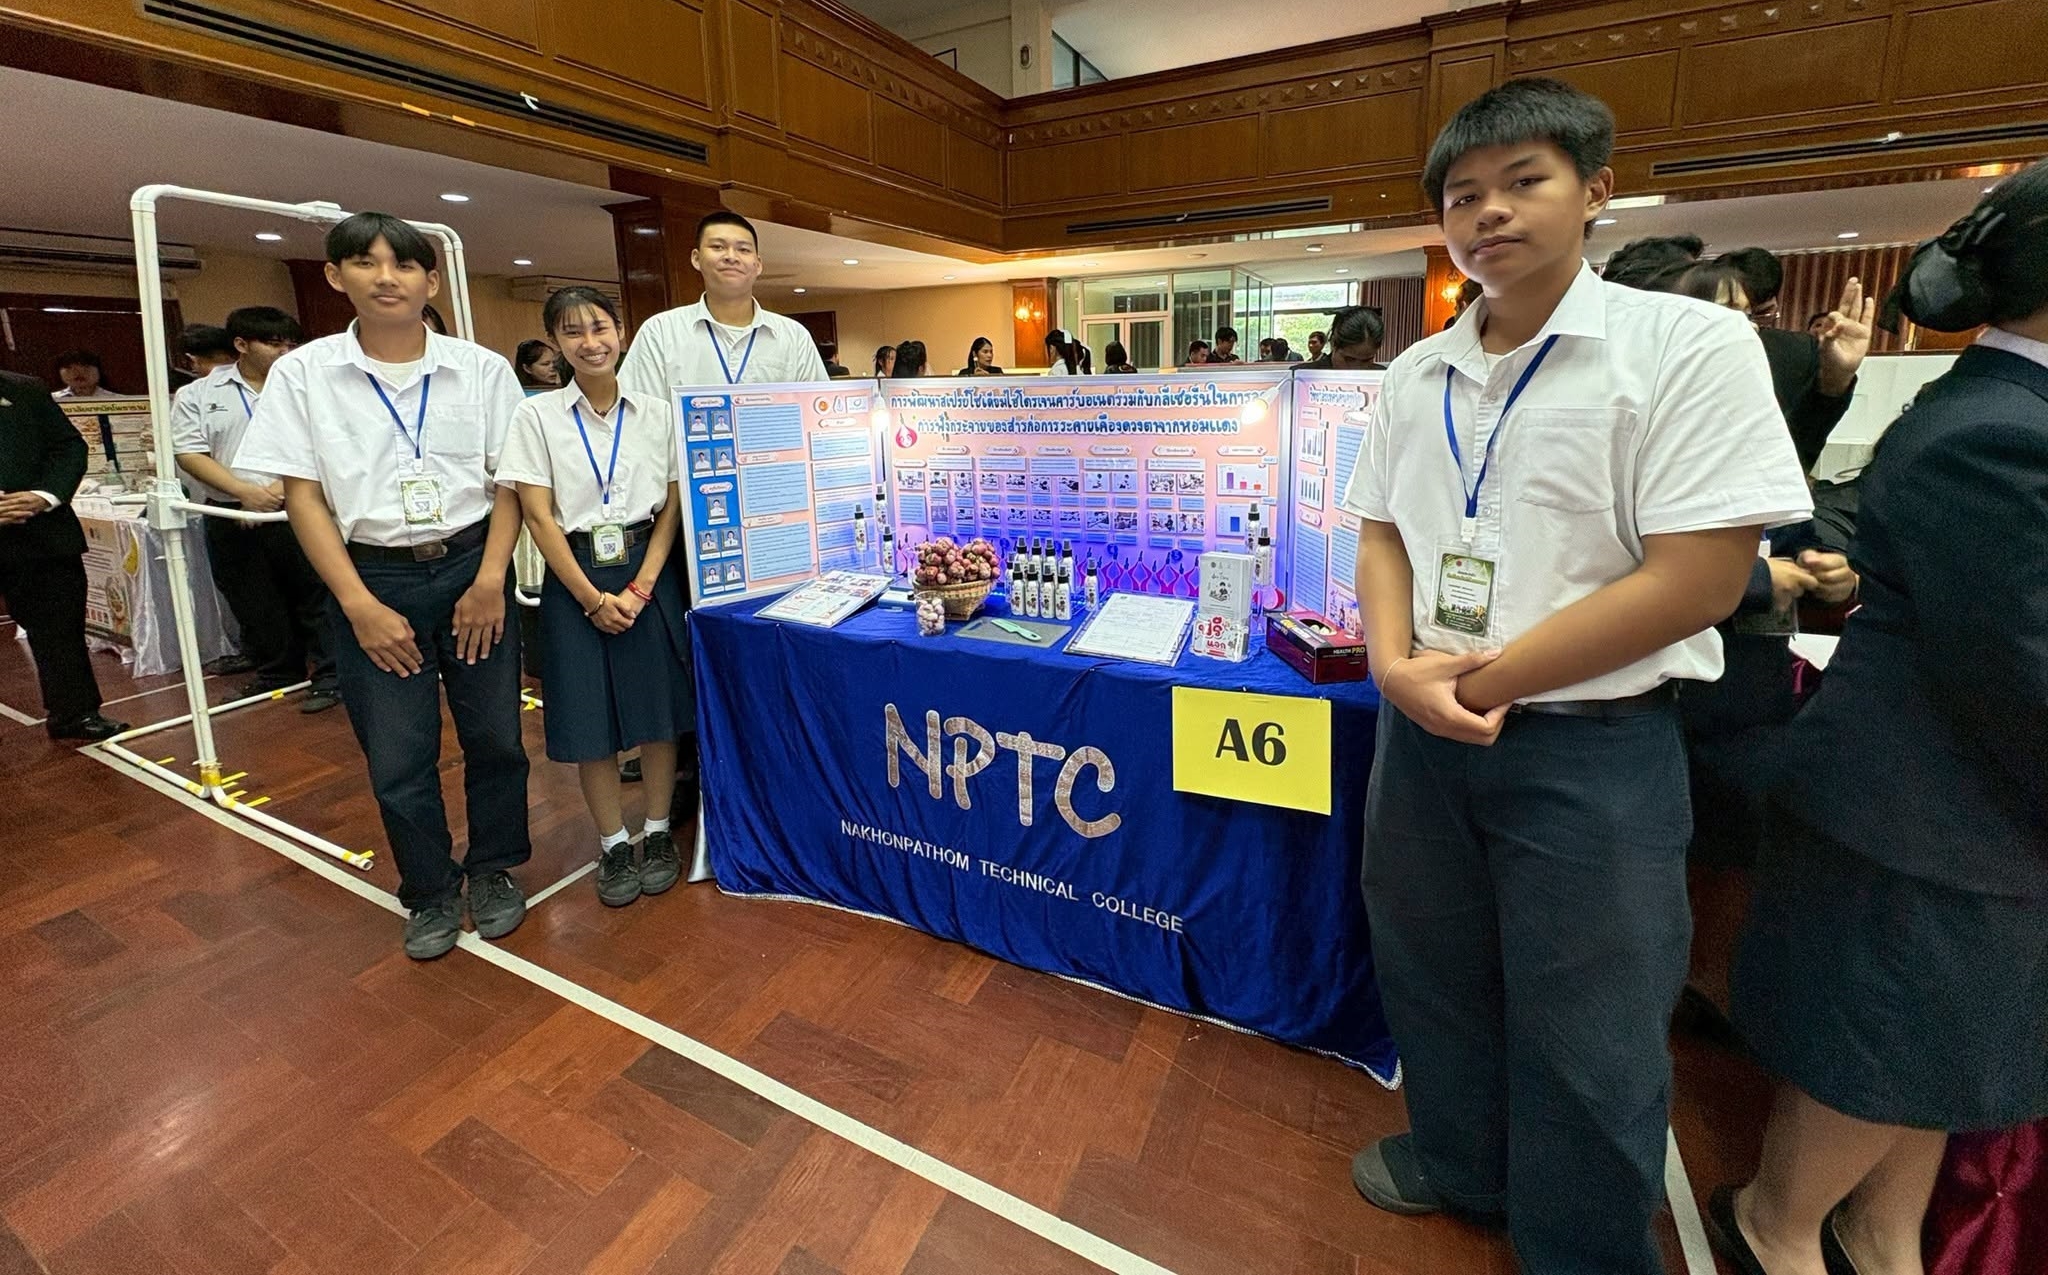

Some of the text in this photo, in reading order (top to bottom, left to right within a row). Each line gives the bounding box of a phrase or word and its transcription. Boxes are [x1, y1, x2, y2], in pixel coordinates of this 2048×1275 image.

[1351, 646, 1365, 654] PRO
[884, 702, 1122, 838] NPTC
[1214, 717, 1288, 767] A6
[841, 819, 1184, 934] NAKHONPATHOM TECHNICAL COLLEGE
